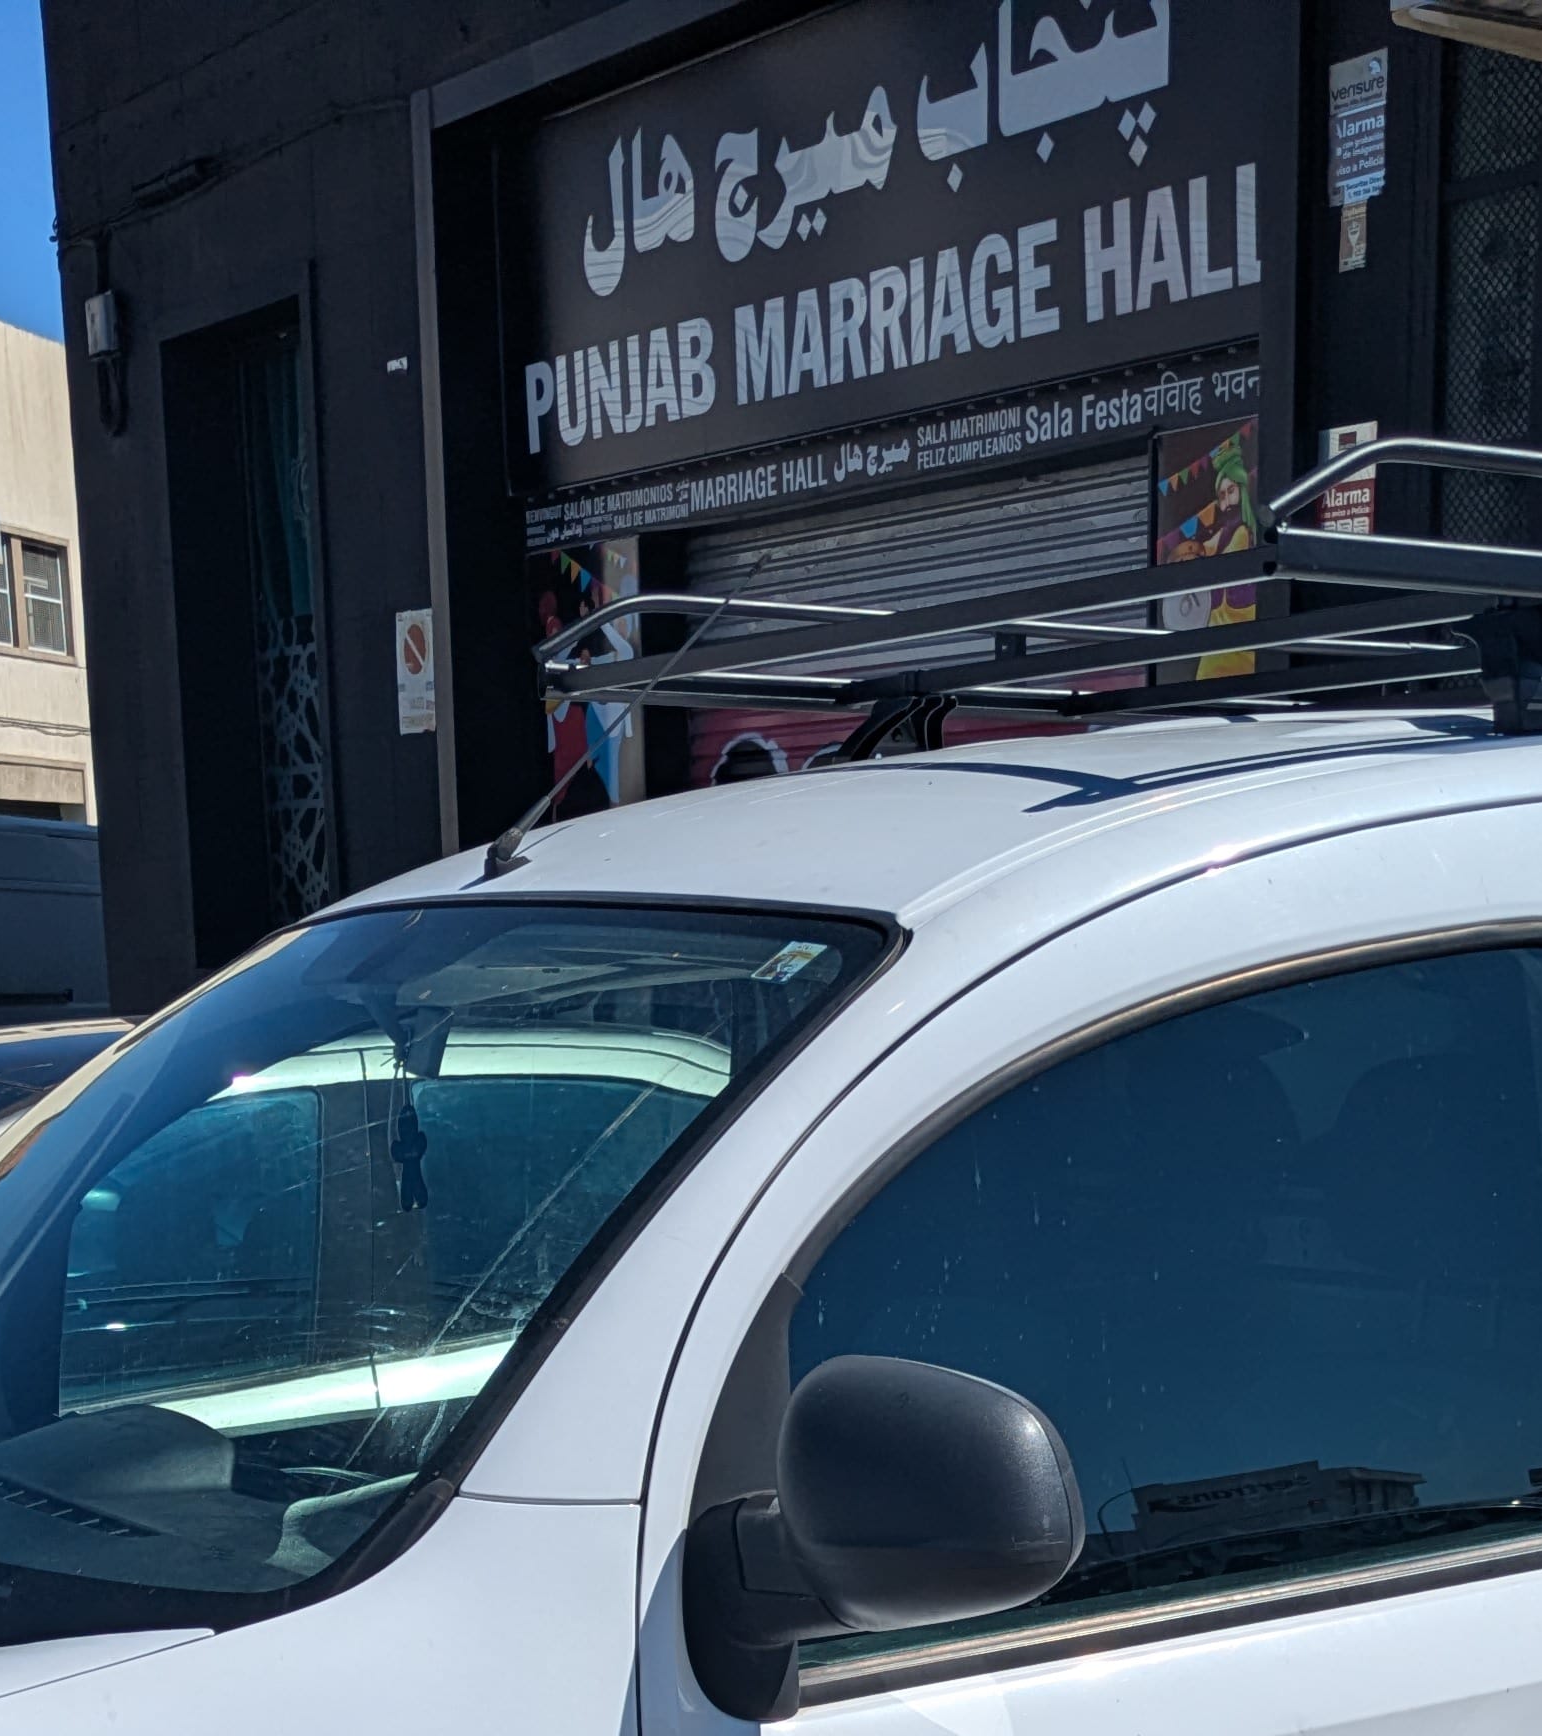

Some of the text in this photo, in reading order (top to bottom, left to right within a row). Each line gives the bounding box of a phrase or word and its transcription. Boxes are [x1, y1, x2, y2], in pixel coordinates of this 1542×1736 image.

[524, 162, 1262, 455] PUNJAB MARRIAGE HALL
[916, 405, 1022, 448] SALA MATRIMONI
[1024, 387, 1143, 446] Sala Festa
[916, 430, 1023, 471] FELIZ CUMPLEAÑOS
[563, 496, 592, 522] SALÓN
[594, 500, 605, 514] DE
[607, 482, 674, 513] MATRIMONIOS
[690, 453, 828, 513] MARRIAGE HALL
[1322, 487, 1371, 509] Alarma
[633, 513, 644, 526] DE
[644, 502, 689, 525] MATRIMONI
